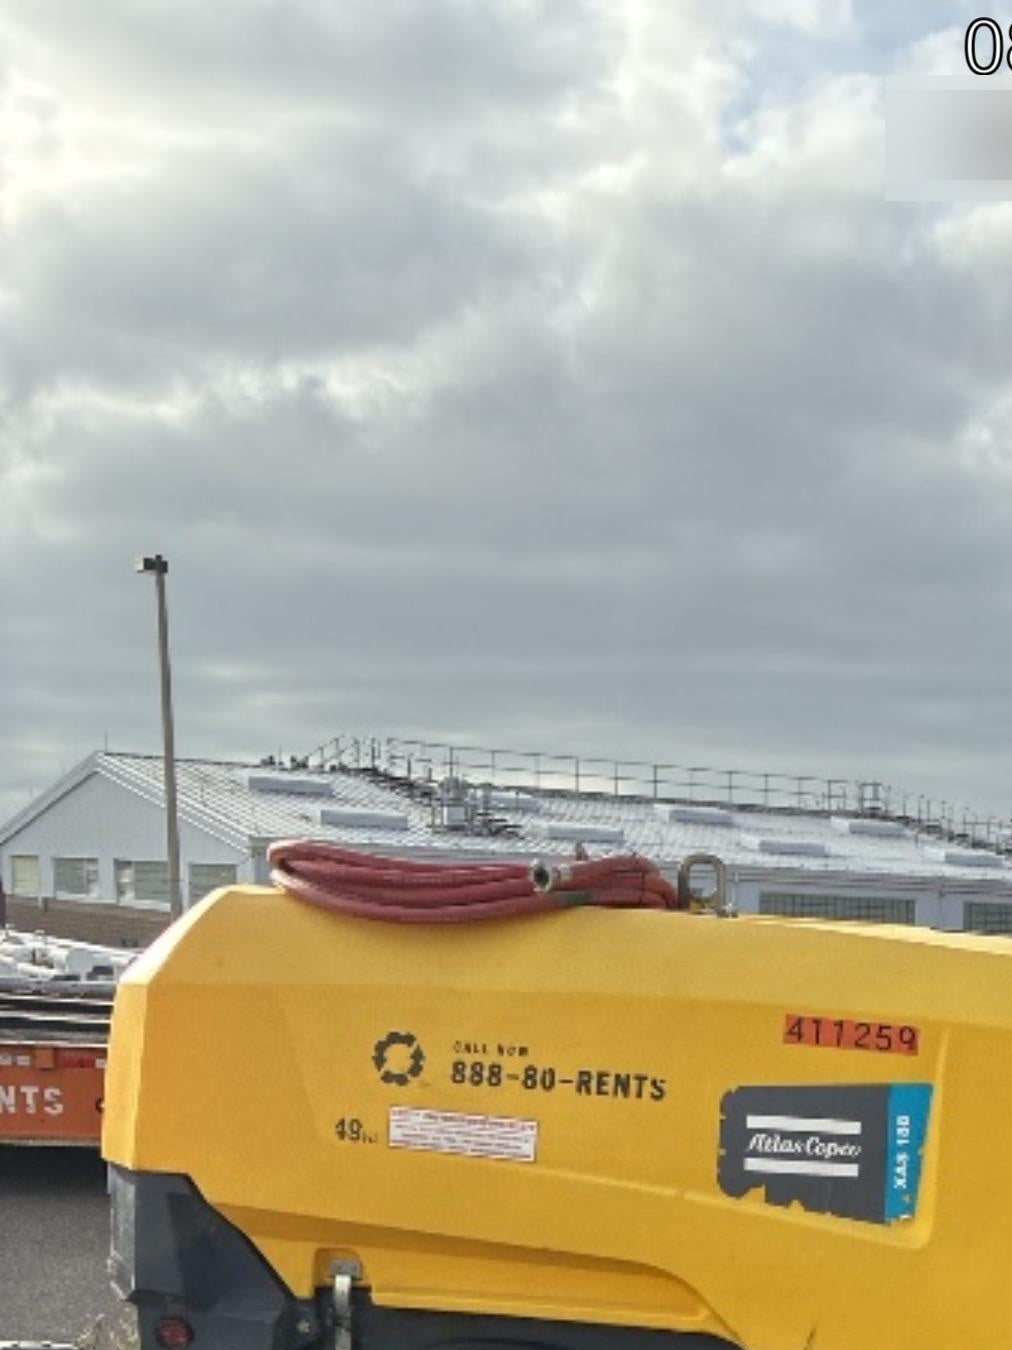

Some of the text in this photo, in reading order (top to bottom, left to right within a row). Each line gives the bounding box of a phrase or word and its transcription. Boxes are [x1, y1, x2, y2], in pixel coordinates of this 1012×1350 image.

[786, 1016, 917, 1053] 411259
[451, 1060, 667, 1102] 888-80-RENTS
[746, 1133, 803, 1153] Atlas
